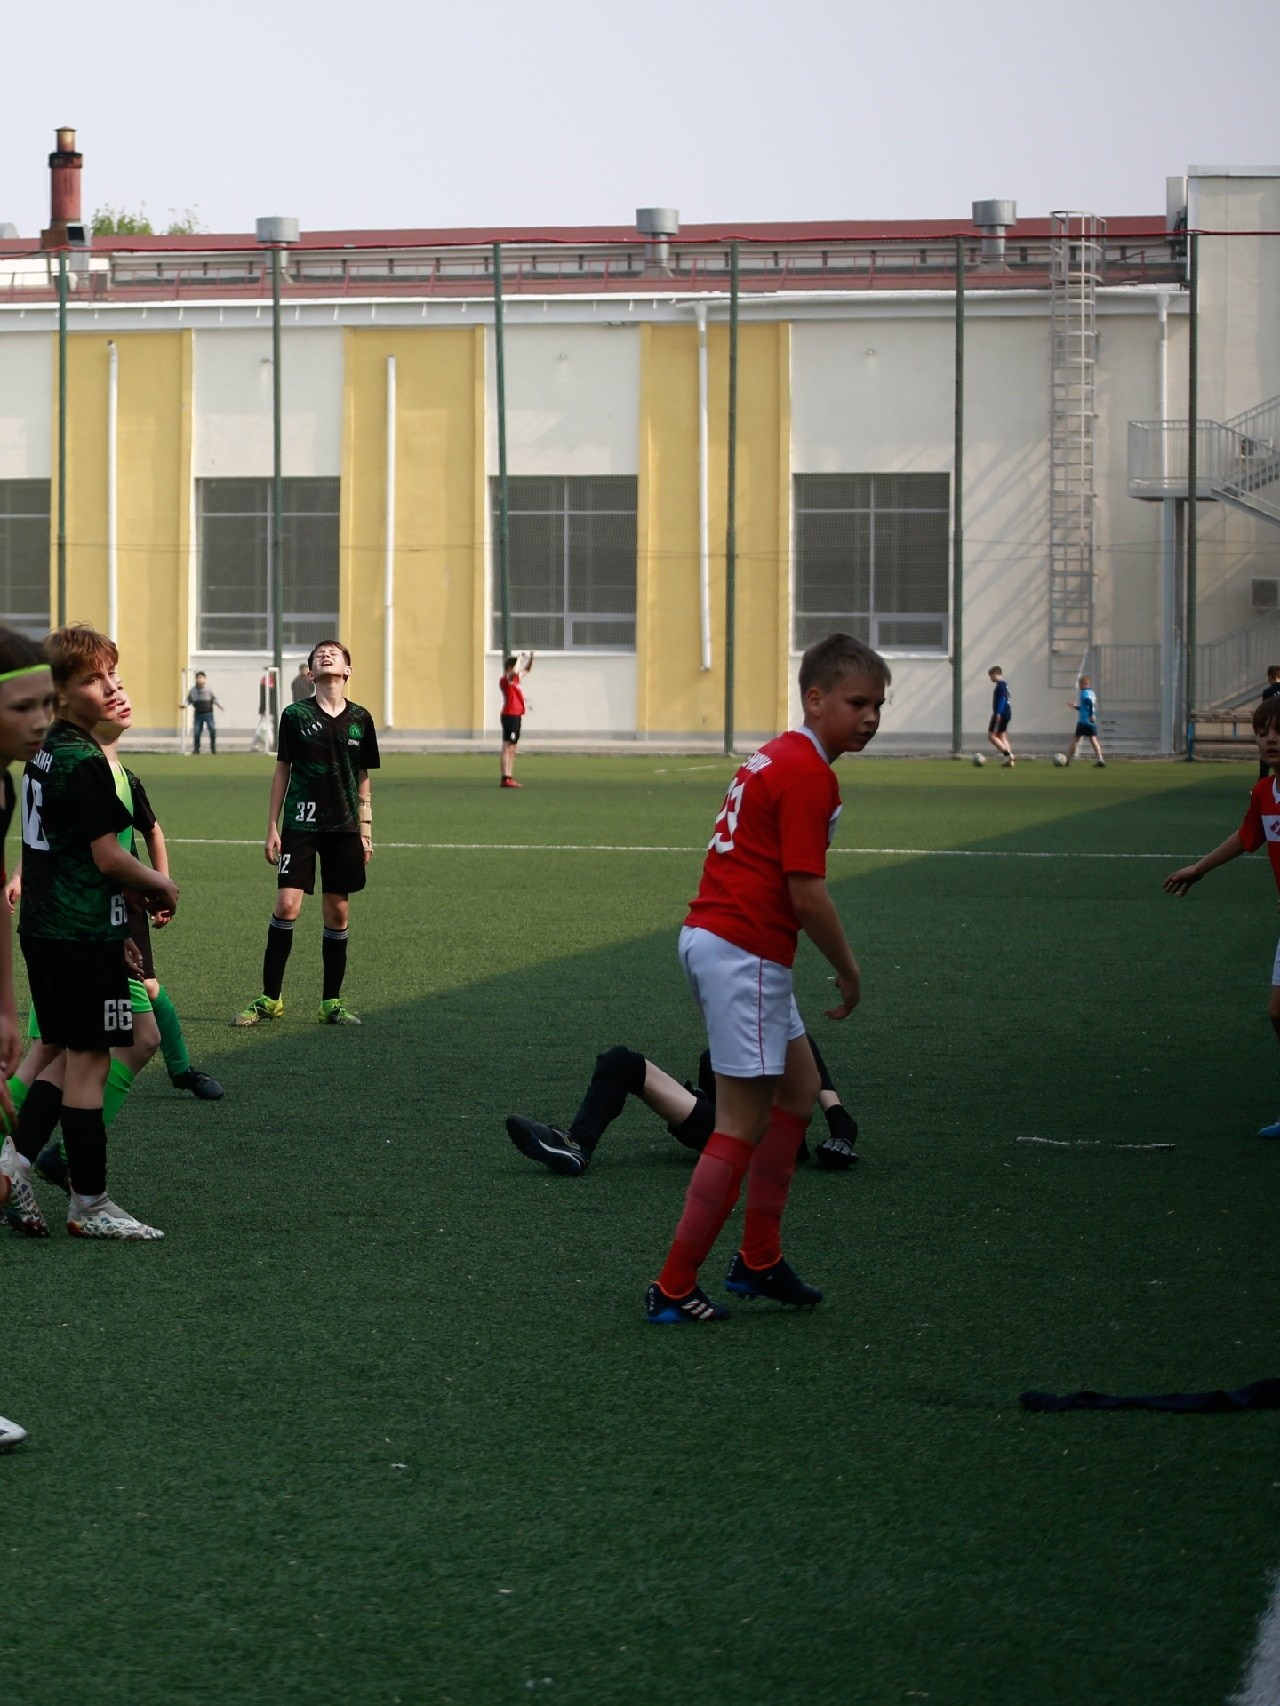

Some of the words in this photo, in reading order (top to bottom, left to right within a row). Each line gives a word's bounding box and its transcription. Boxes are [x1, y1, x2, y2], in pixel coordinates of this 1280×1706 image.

[295, 802, 317, 822] 32
[278, 853, 291, 874] 2
[104, 999, 133, 1032] 66
